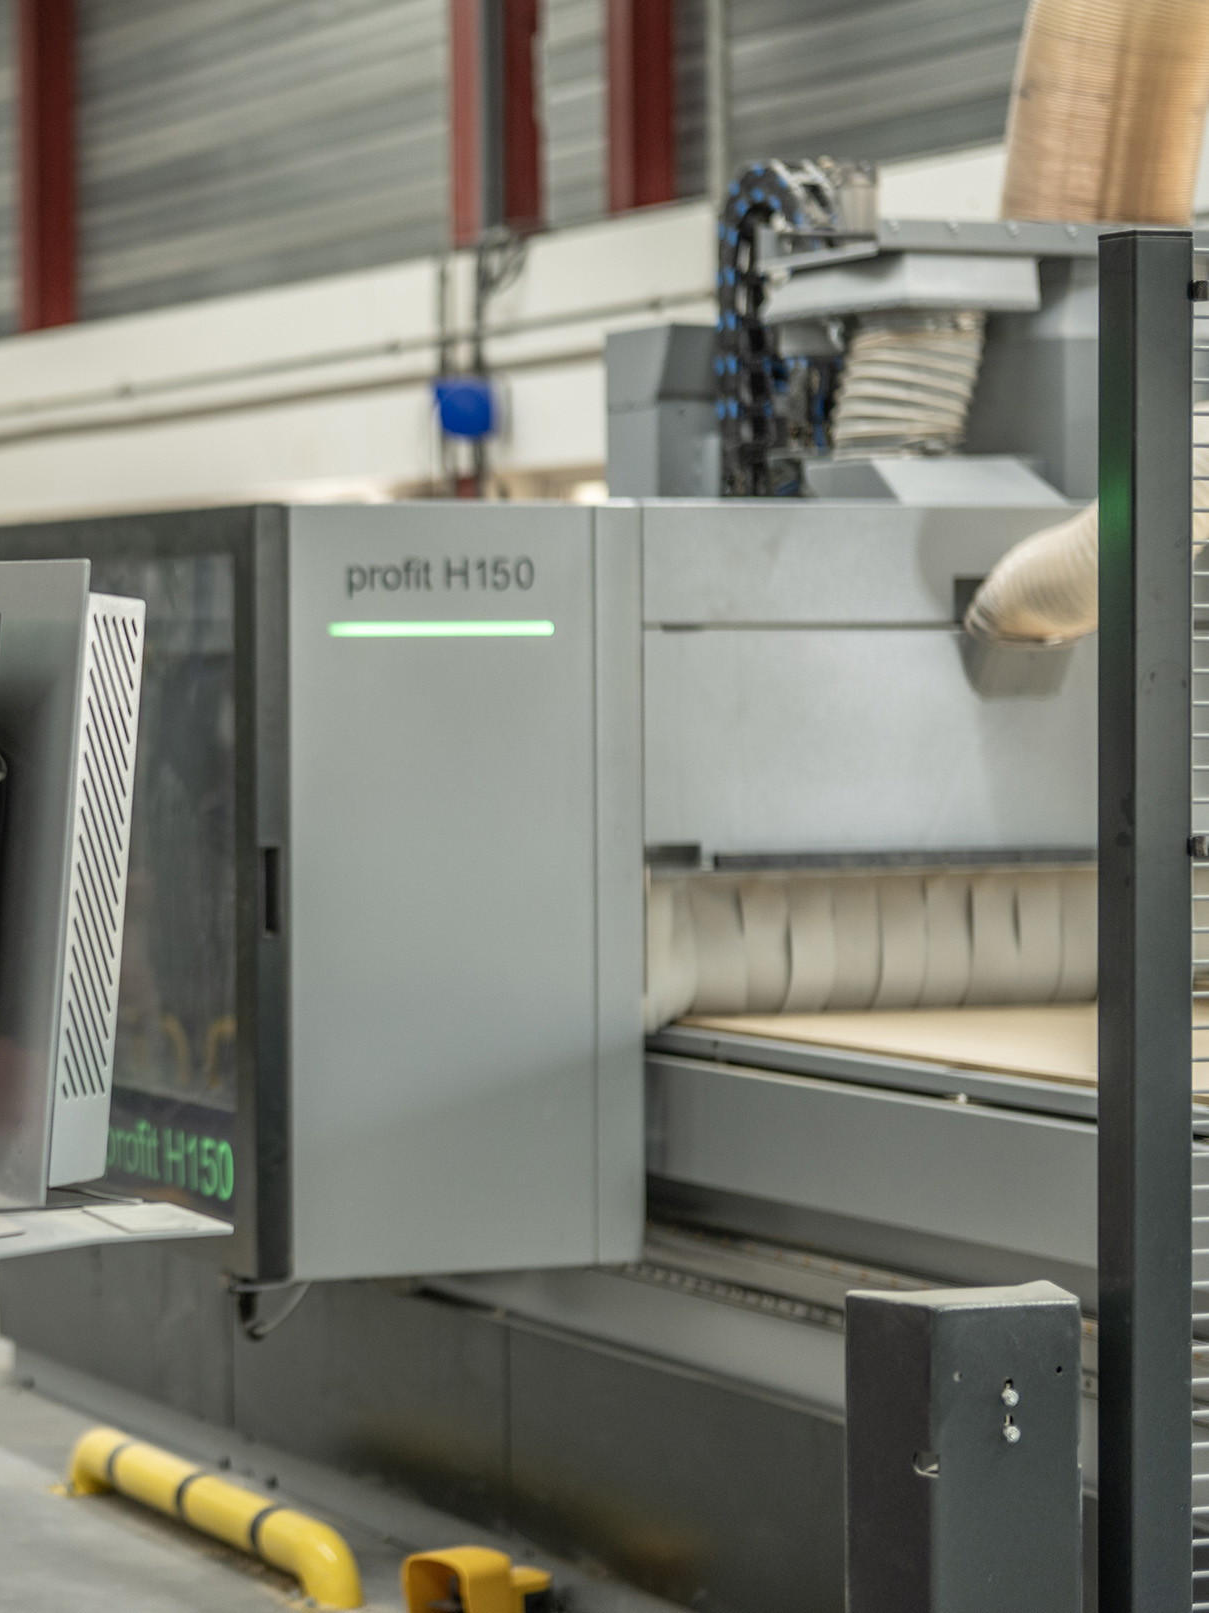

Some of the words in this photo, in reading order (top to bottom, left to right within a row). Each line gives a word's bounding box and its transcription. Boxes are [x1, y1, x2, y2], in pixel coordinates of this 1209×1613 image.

[346, 557, 433, 599] profit
[444, 555, 535, 592] H150
[161, 1125, 234, 1201] H150
